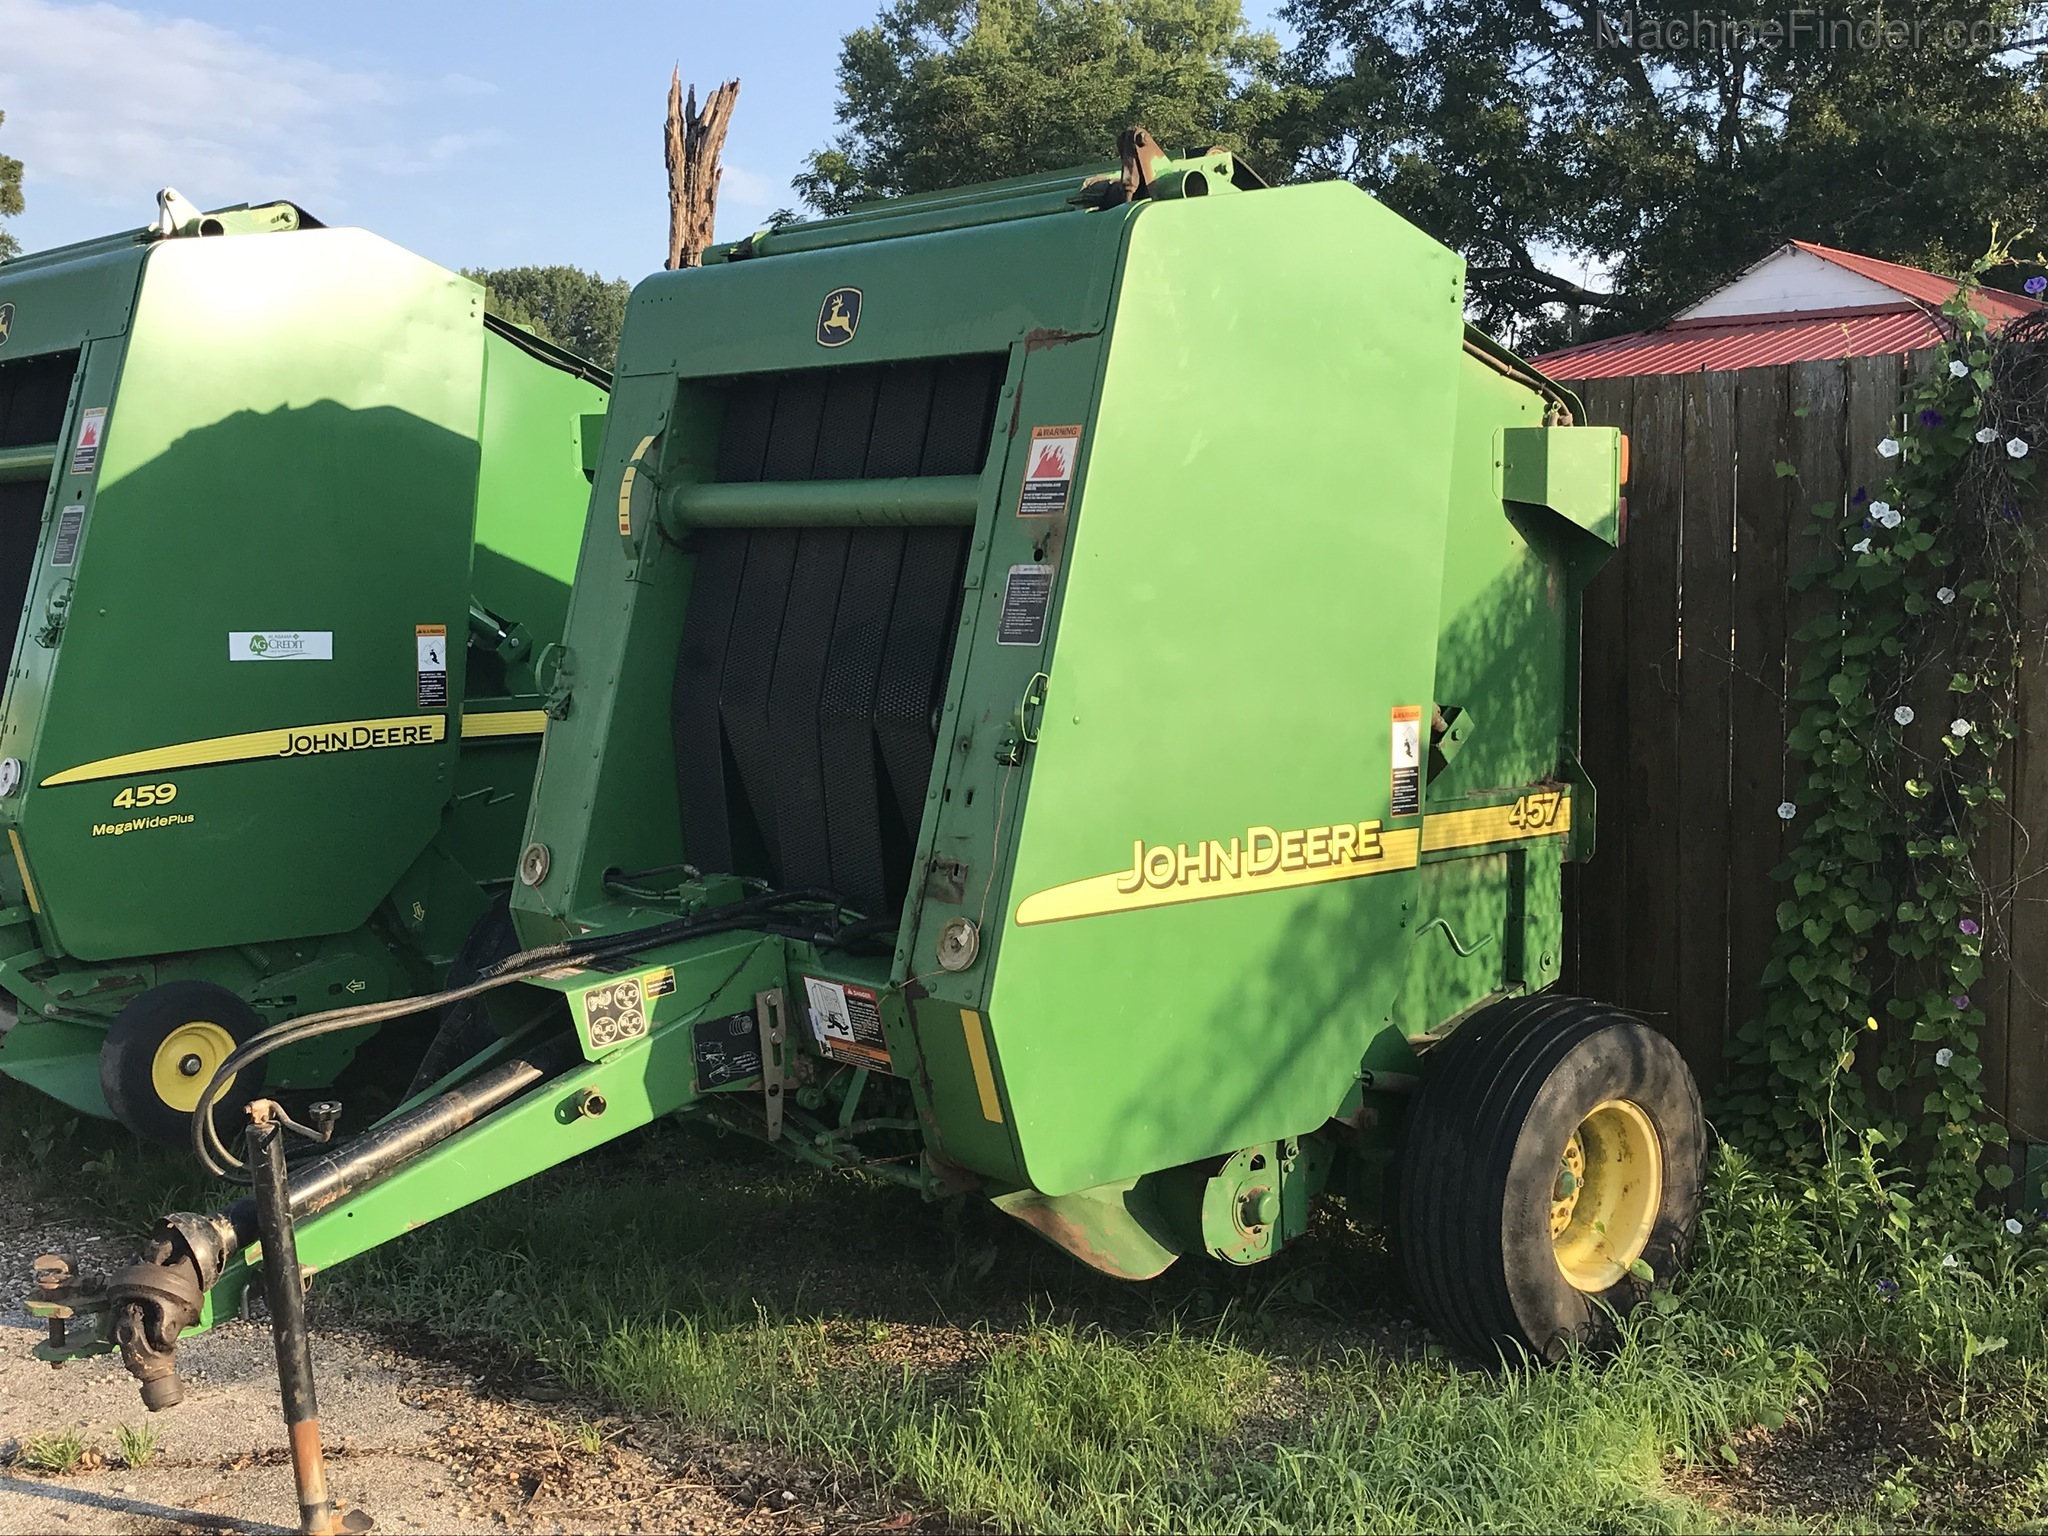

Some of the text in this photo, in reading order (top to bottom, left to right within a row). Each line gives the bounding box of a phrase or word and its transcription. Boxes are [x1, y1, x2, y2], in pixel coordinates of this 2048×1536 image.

[1043, 427, 1077, 437] WARNING
[251, 639, 305, 649] AG CREDIT
[279, 725, 433, 754] JOHN DEERE
[112, 782, 178, 809] 459
[1508, 791, 1562, 830] 457
[92, 814, 195, 836] MegaWidePlus
[1117, 819, 1383, 894] JOHN DEERE
